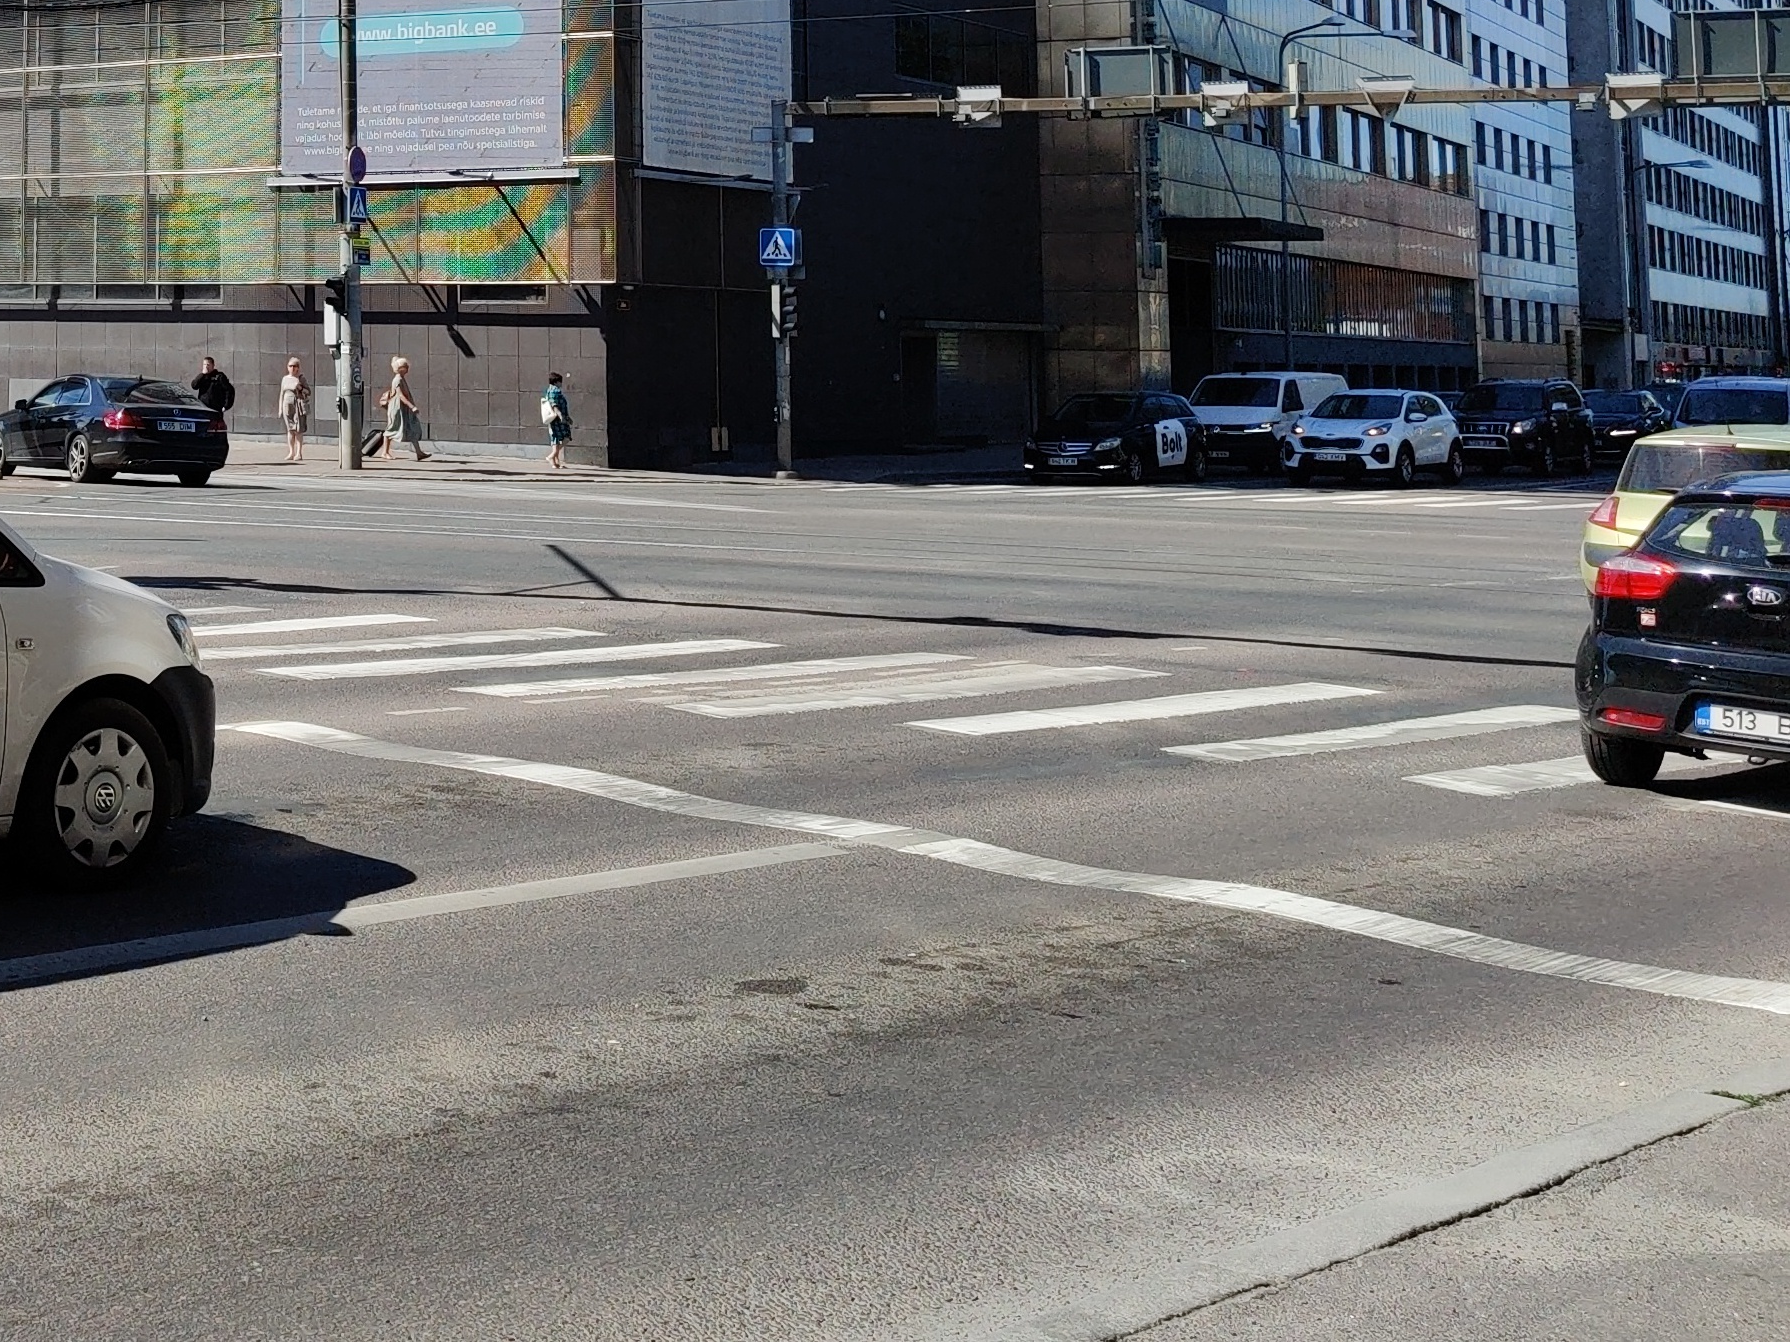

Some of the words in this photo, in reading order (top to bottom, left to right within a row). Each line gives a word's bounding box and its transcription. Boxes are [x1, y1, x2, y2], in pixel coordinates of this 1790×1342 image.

[357, 19, 497, 45] ww.bigbank.ee
[383, 103, 397, 115] iga
[470, 98, 518, 109] kaasnevad
[519, 96, 545, 107] riskid
[296, 120, 315, 130] ning
[406, 116, 440, 126] palume
[295, 132, 327, 144] vajadus
[374, 143, 394, 154] ning
[438, 142, 455, 152] pea
[1161, 430, 1183, 455] Bolt
[1752, 587, 1777, 603] KIA
[1722, 708, 1757, 730] 513
